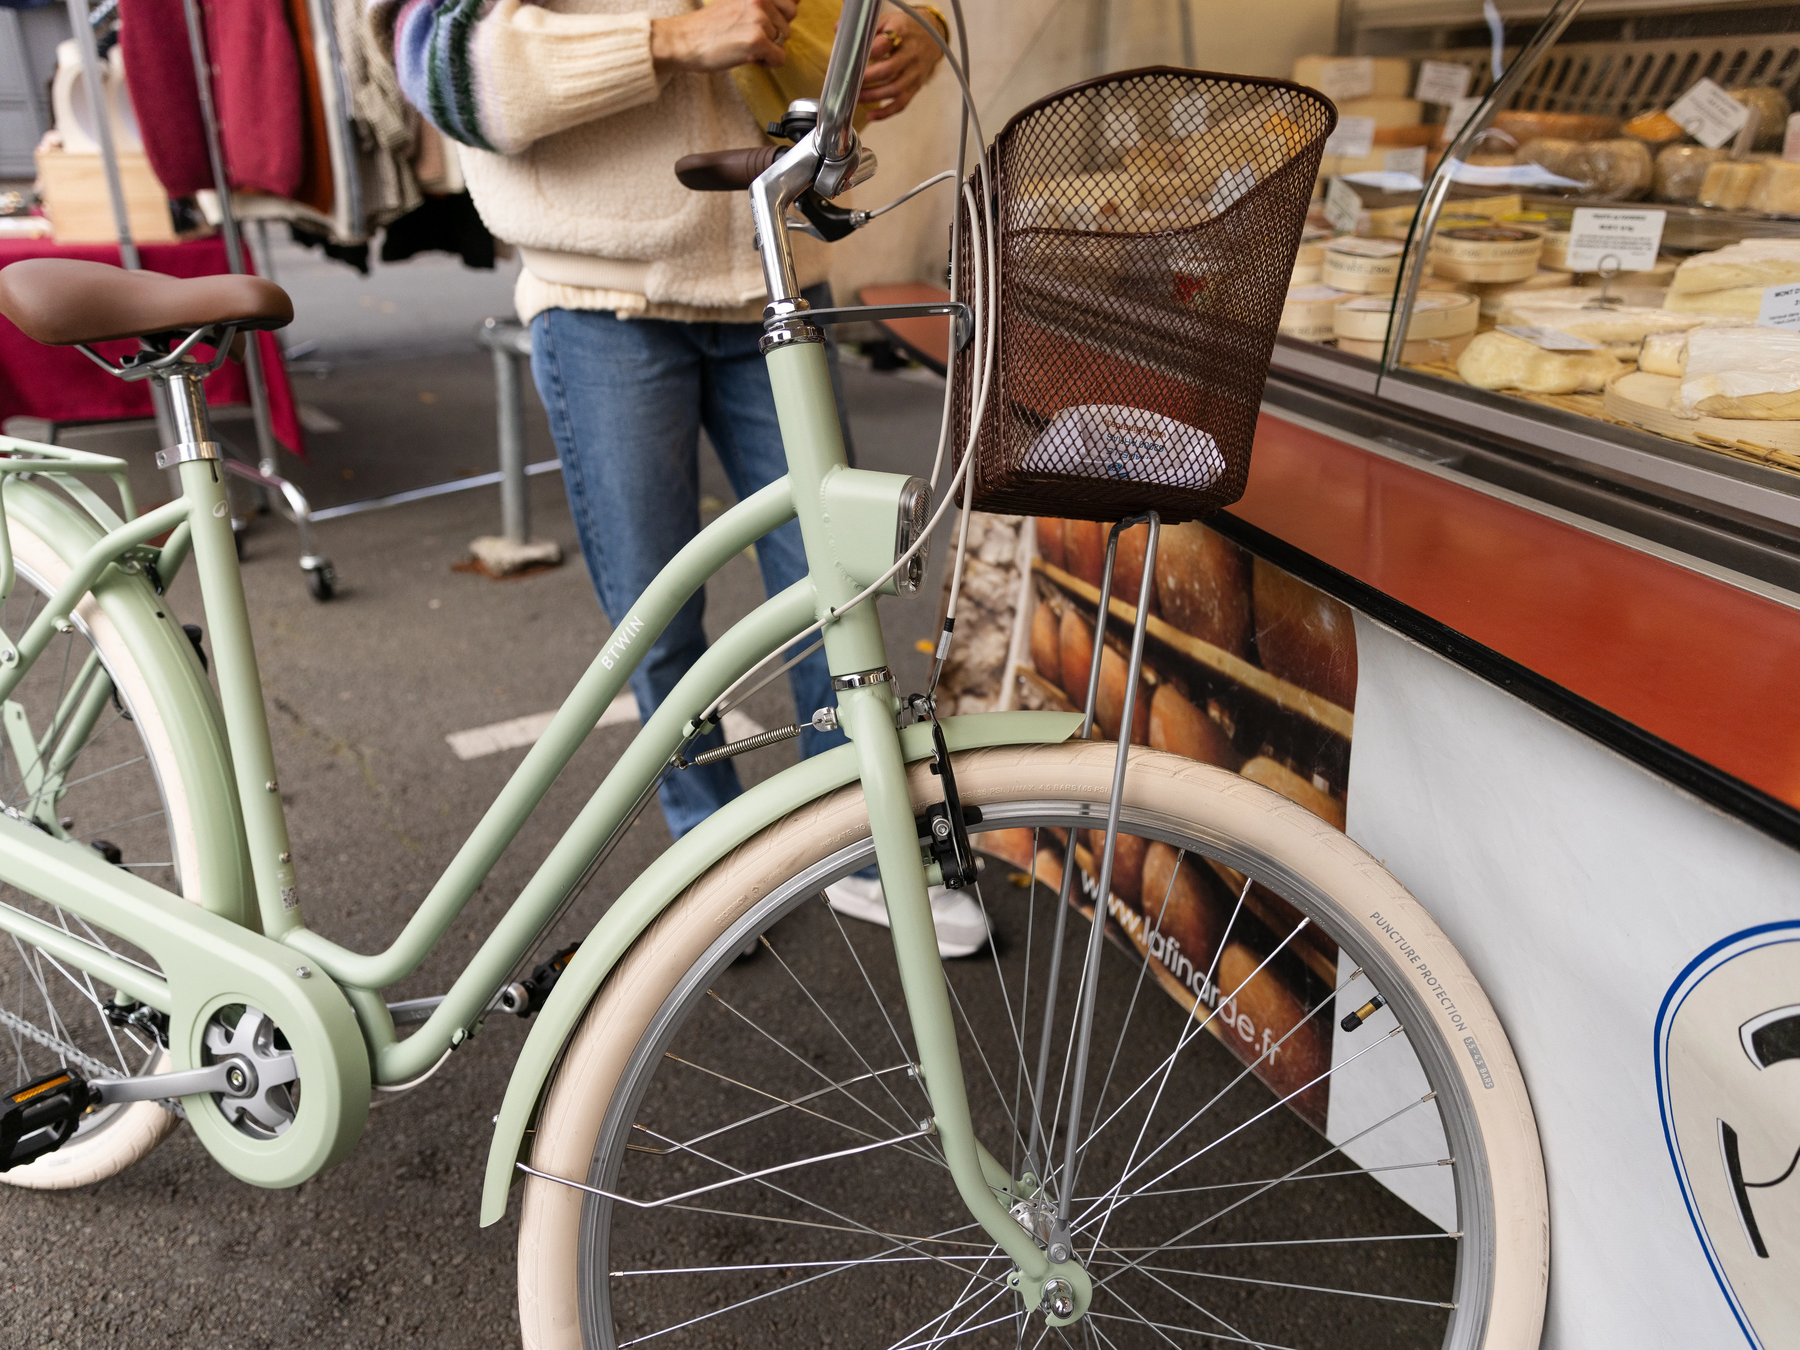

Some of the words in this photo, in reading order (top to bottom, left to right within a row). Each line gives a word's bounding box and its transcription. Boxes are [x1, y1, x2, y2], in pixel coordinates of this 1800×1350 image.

[600, 615, 645, 671] BTWIN
[854, 823, 867, 833] TO
[1369, 911, 1421, 964] PUNCTURE
[1416, 963, 1468, 1032] PROTECTION
[1465, 1037, 1476, 1049] 3,5
[1474, 1054, 1484, 1066] 4,5
[1479, 1067, 1493, 1088] BARS
